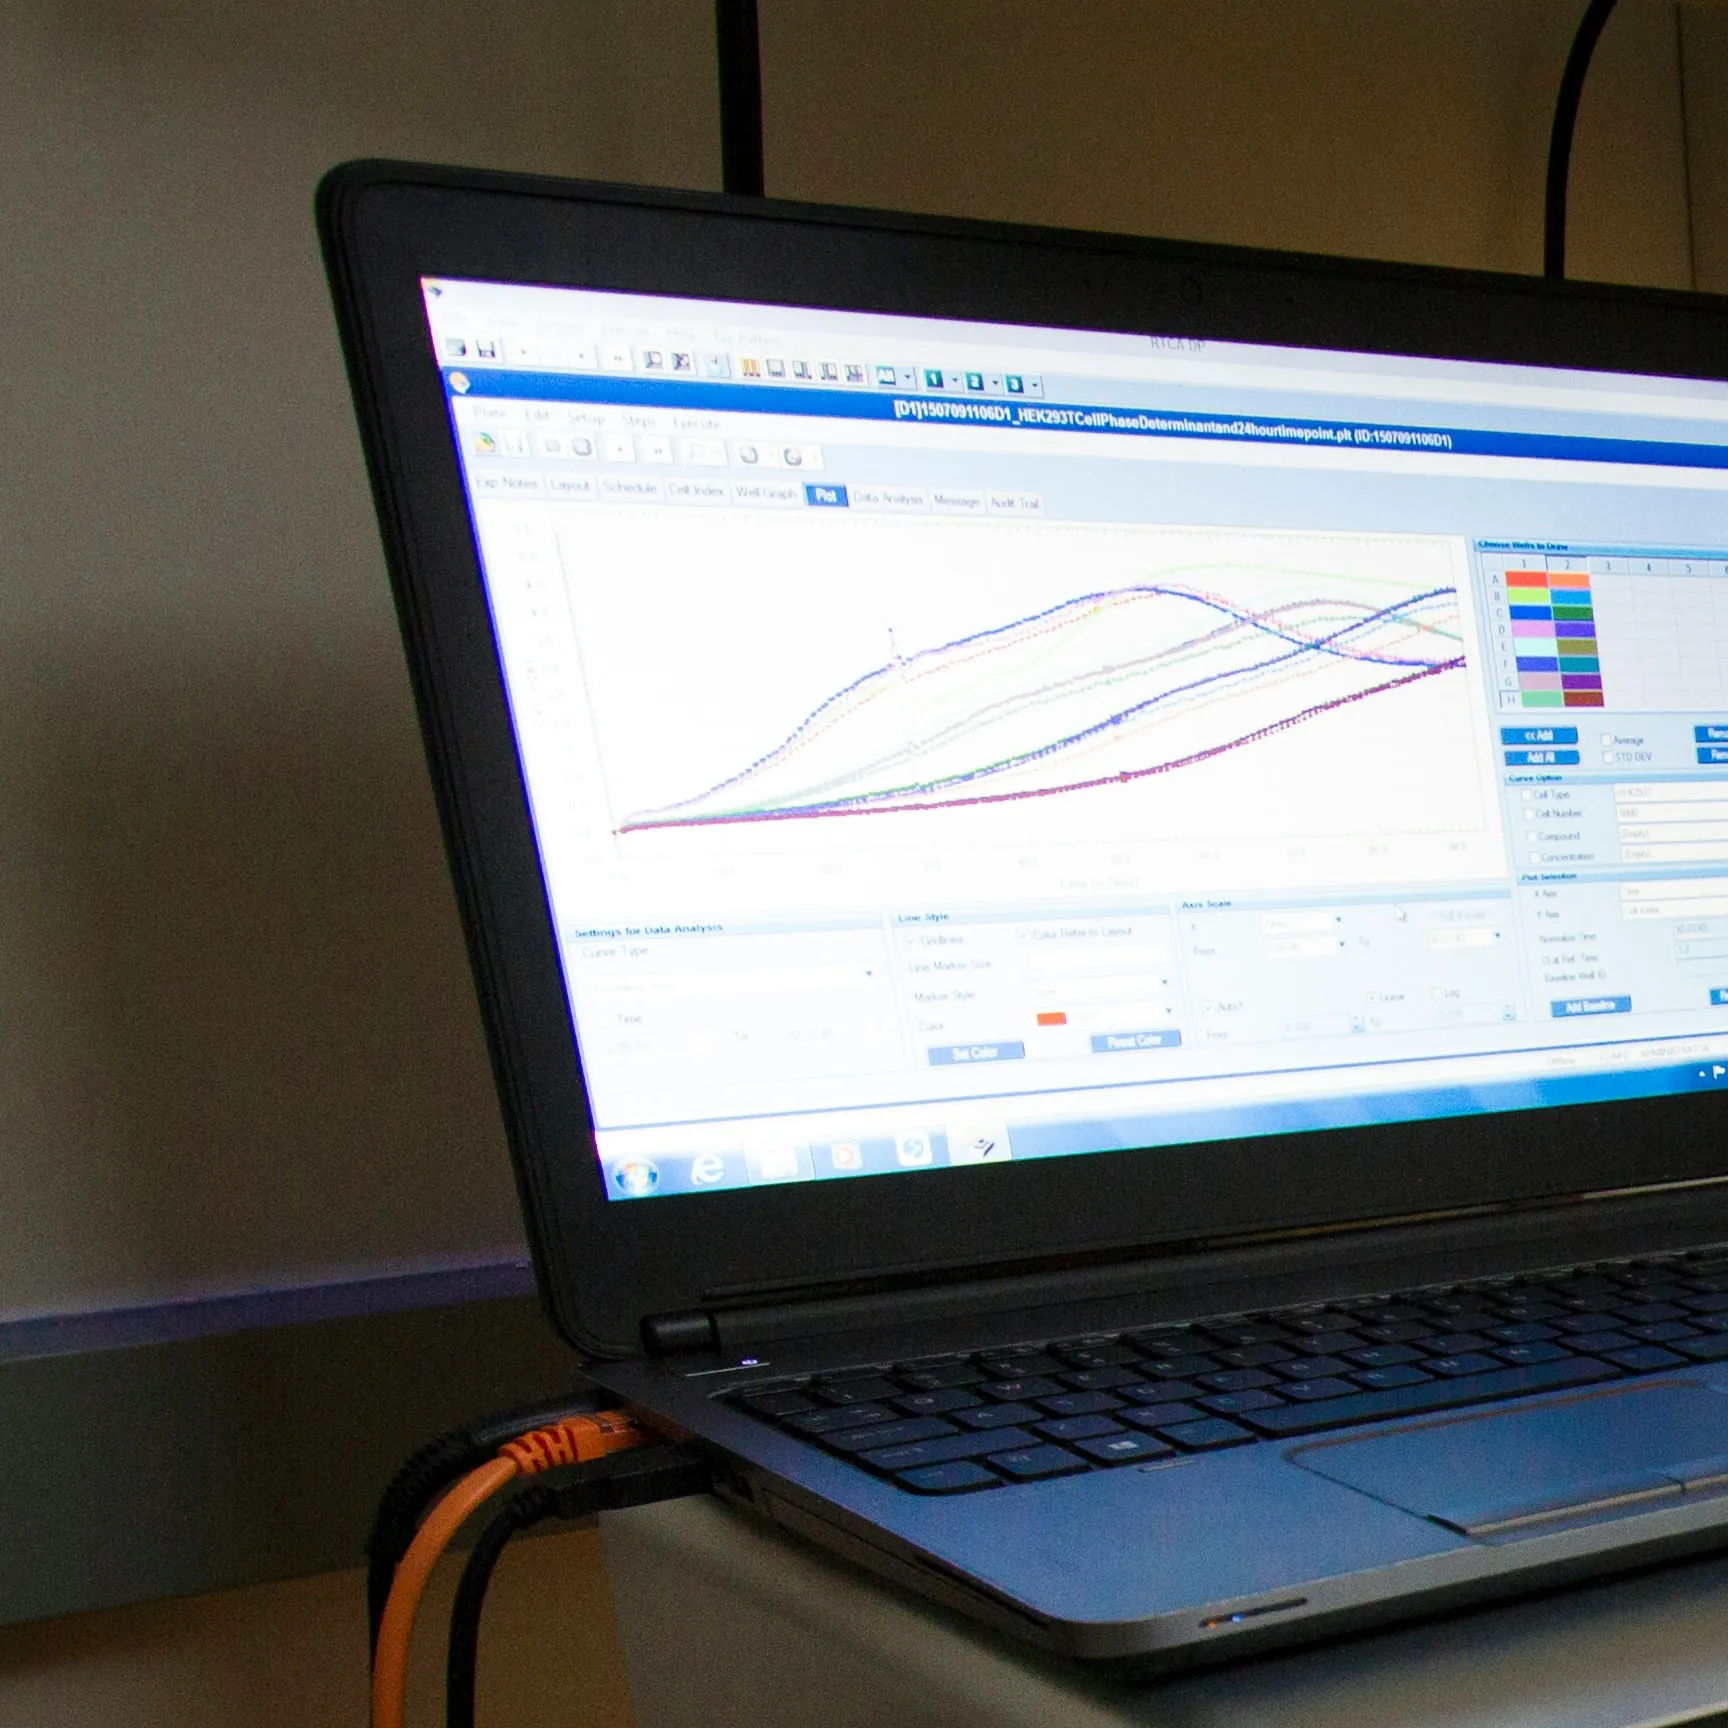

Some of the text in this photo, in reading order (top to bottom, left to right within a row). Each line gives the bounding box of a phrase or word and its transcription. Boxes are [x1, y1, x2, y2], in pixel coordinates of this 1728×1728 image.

[473, 405, 506, 420] Plate
[567, 410, 606, 427] Setup
[621, 414, 658, 429] Steps
[673, 416, 722, 430] Execute
[475, 477, 539, 491] Exp Notes
[550, 479, 590, 495] Layout
[603, 481, 658, 496] Schedule
[668, 484, 726, 498] Cell Index
[815, 488, 837, 504] Plot
[881, 492, 924, 508] Analysis
[933, 493, 981, 509] Message
[990, 496, 1040, 511] Audit Trail
[1612, 733, 1645, 747] Average
[1634, 750, 1653, 763] DEV
[1533, 788, 1570, 801] Cell Type
[1536, 807, 1582, 819] Cell Number
[1539, 830, 1581, 843] Compound
[1541, 852, 1595, 864] Concentration
[582, 945, 650, 959] Curve Type
[617, 1013, 644, 1026] Time
